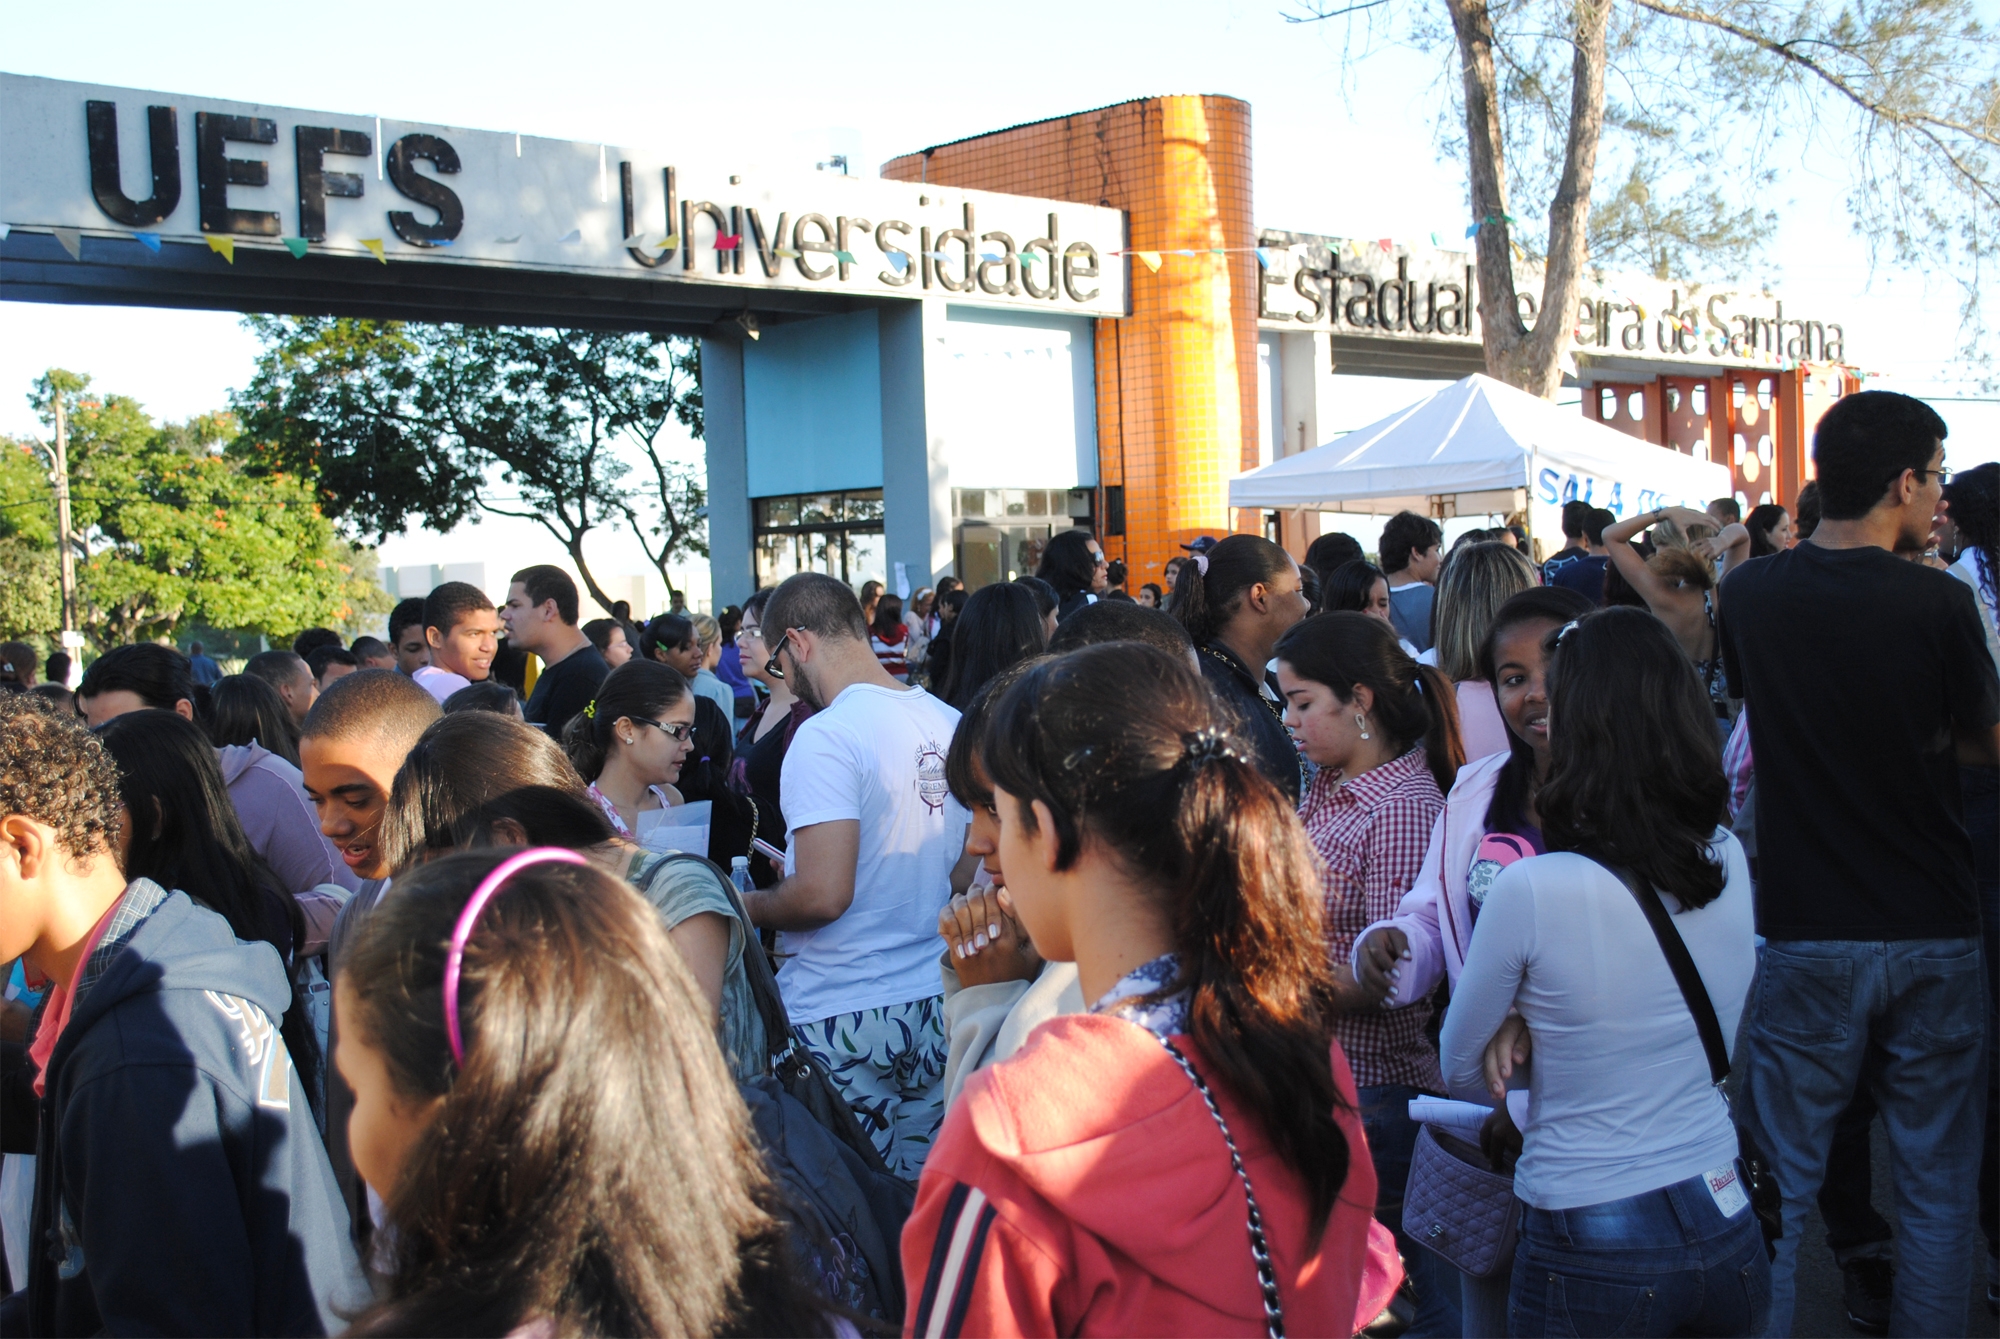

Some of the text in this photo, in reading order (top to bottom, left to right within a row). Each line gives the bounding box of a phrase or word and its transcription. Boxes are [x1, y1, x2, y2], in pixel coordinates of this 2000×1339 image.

[86, 99, 1100, 302] UEFS Universidade
[1258, 238, 1475, 336] Estadual
[1574, 296, 1646, 350] eira
[1657, 289, 1699, 355] de
[1707, 294, 1845, 365] Santana
